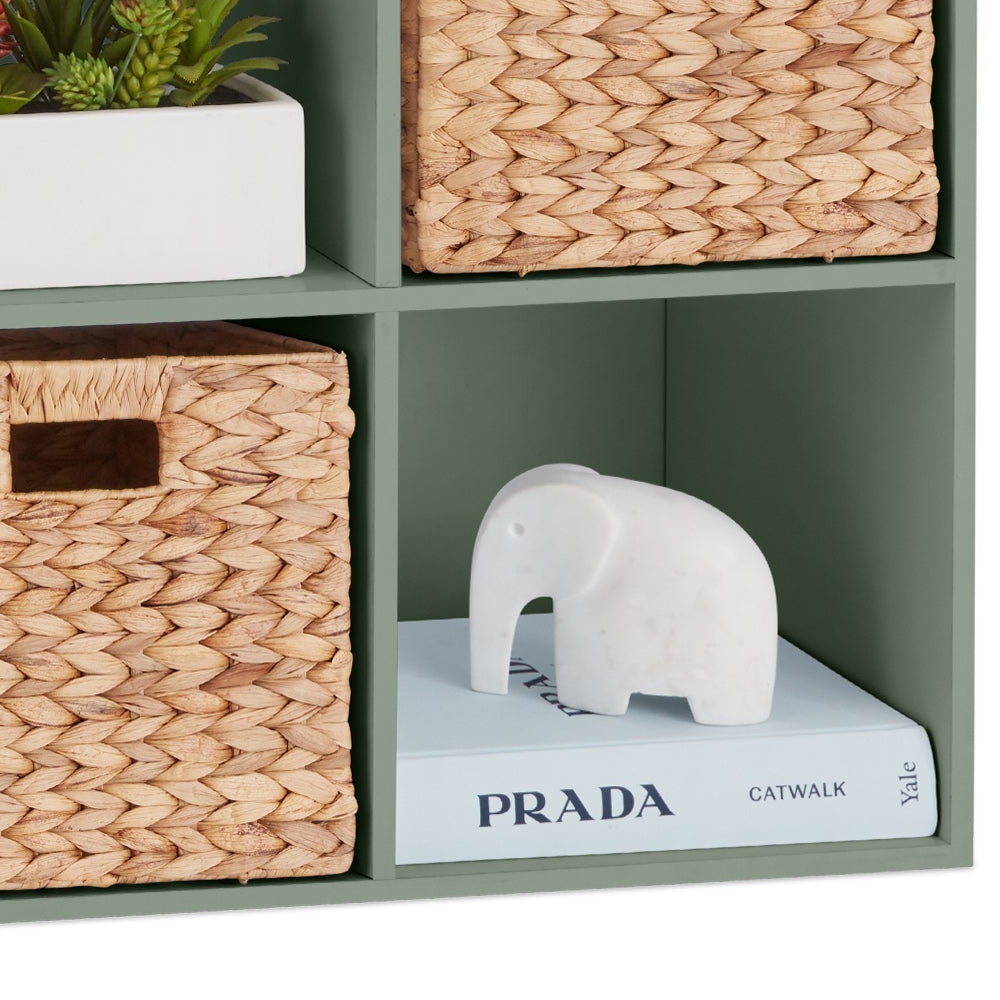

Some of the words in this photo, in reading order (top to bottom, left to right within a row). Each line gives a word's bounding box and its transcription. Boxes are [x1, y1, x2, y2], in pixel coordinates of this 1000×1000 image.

[476, 783, 676, 828] PRADA
[748, 781, 847, 802] CATWALK
[899, 761, 919, 807] Yale
